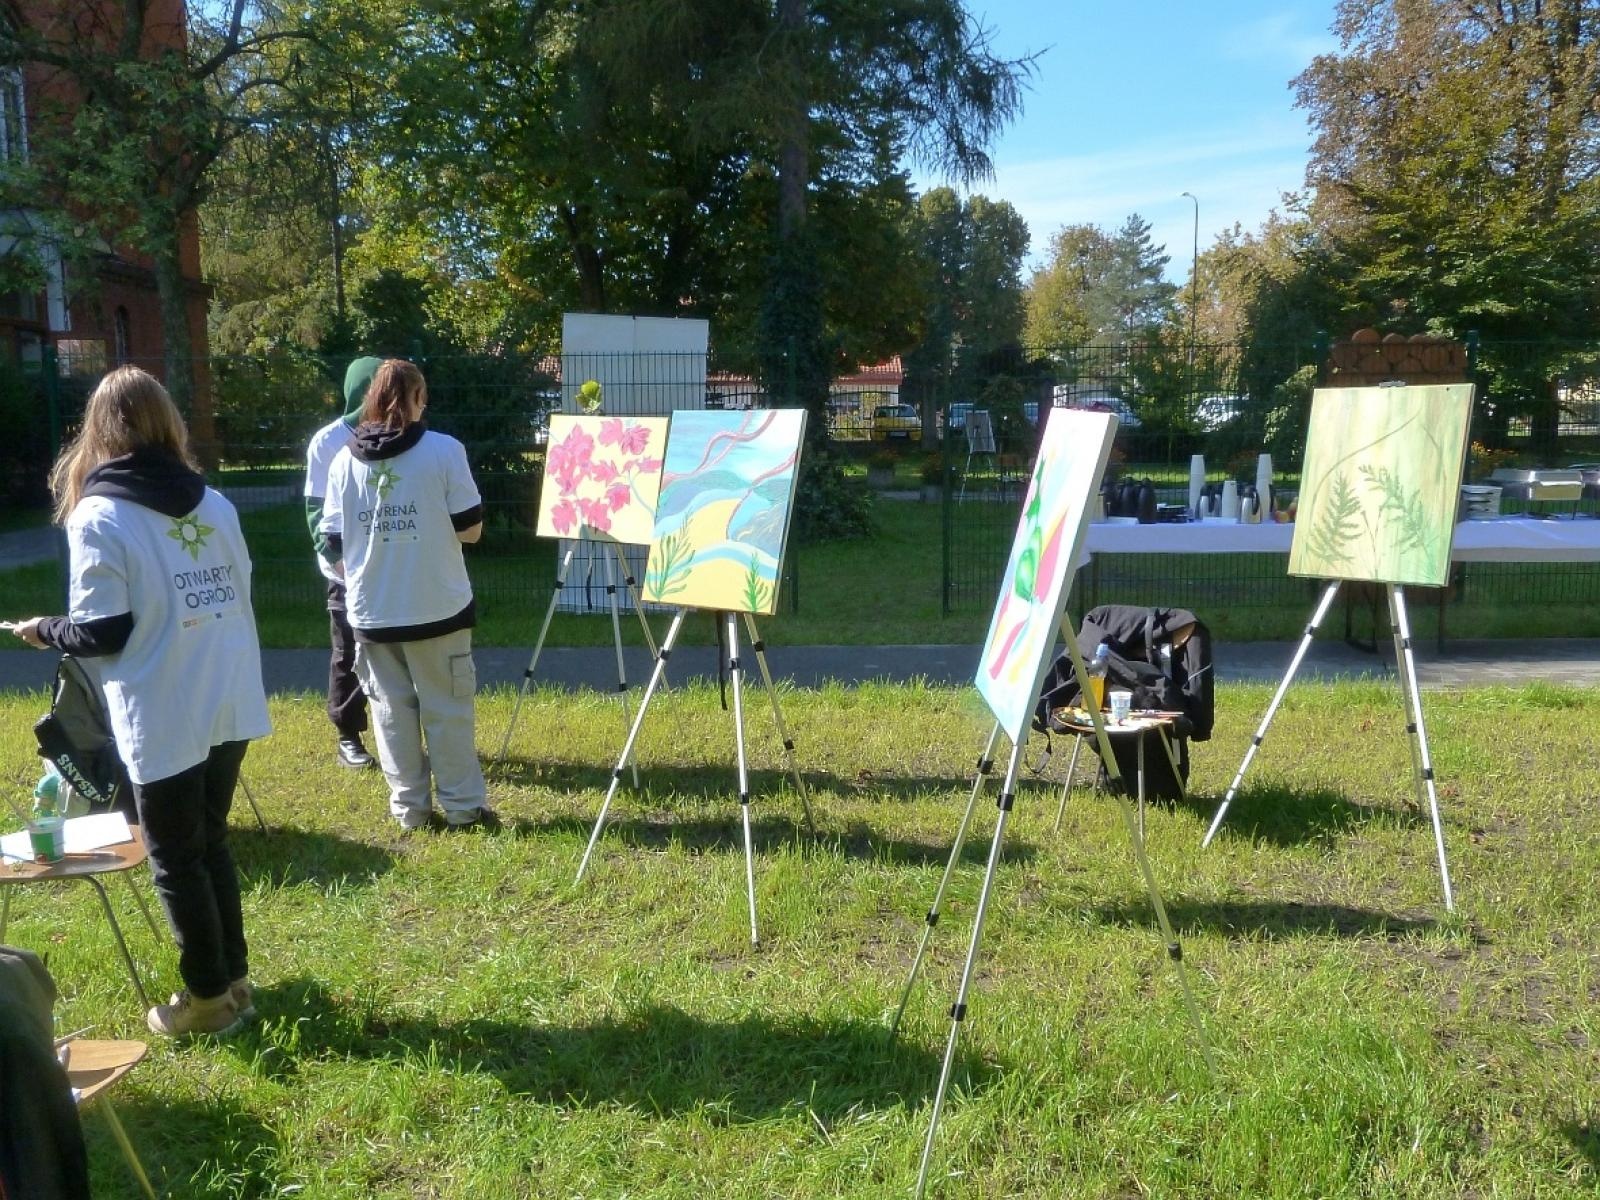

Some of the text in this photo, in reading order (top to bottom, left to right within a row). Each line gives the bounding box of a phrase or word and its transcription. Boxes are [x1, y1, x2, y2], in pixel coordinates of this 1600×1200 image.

[362, 519, 417, 535] ZHRADA
[174, 565, 233, 590] OTWARTY
[185, 583, 235, 609] OGRÓD
